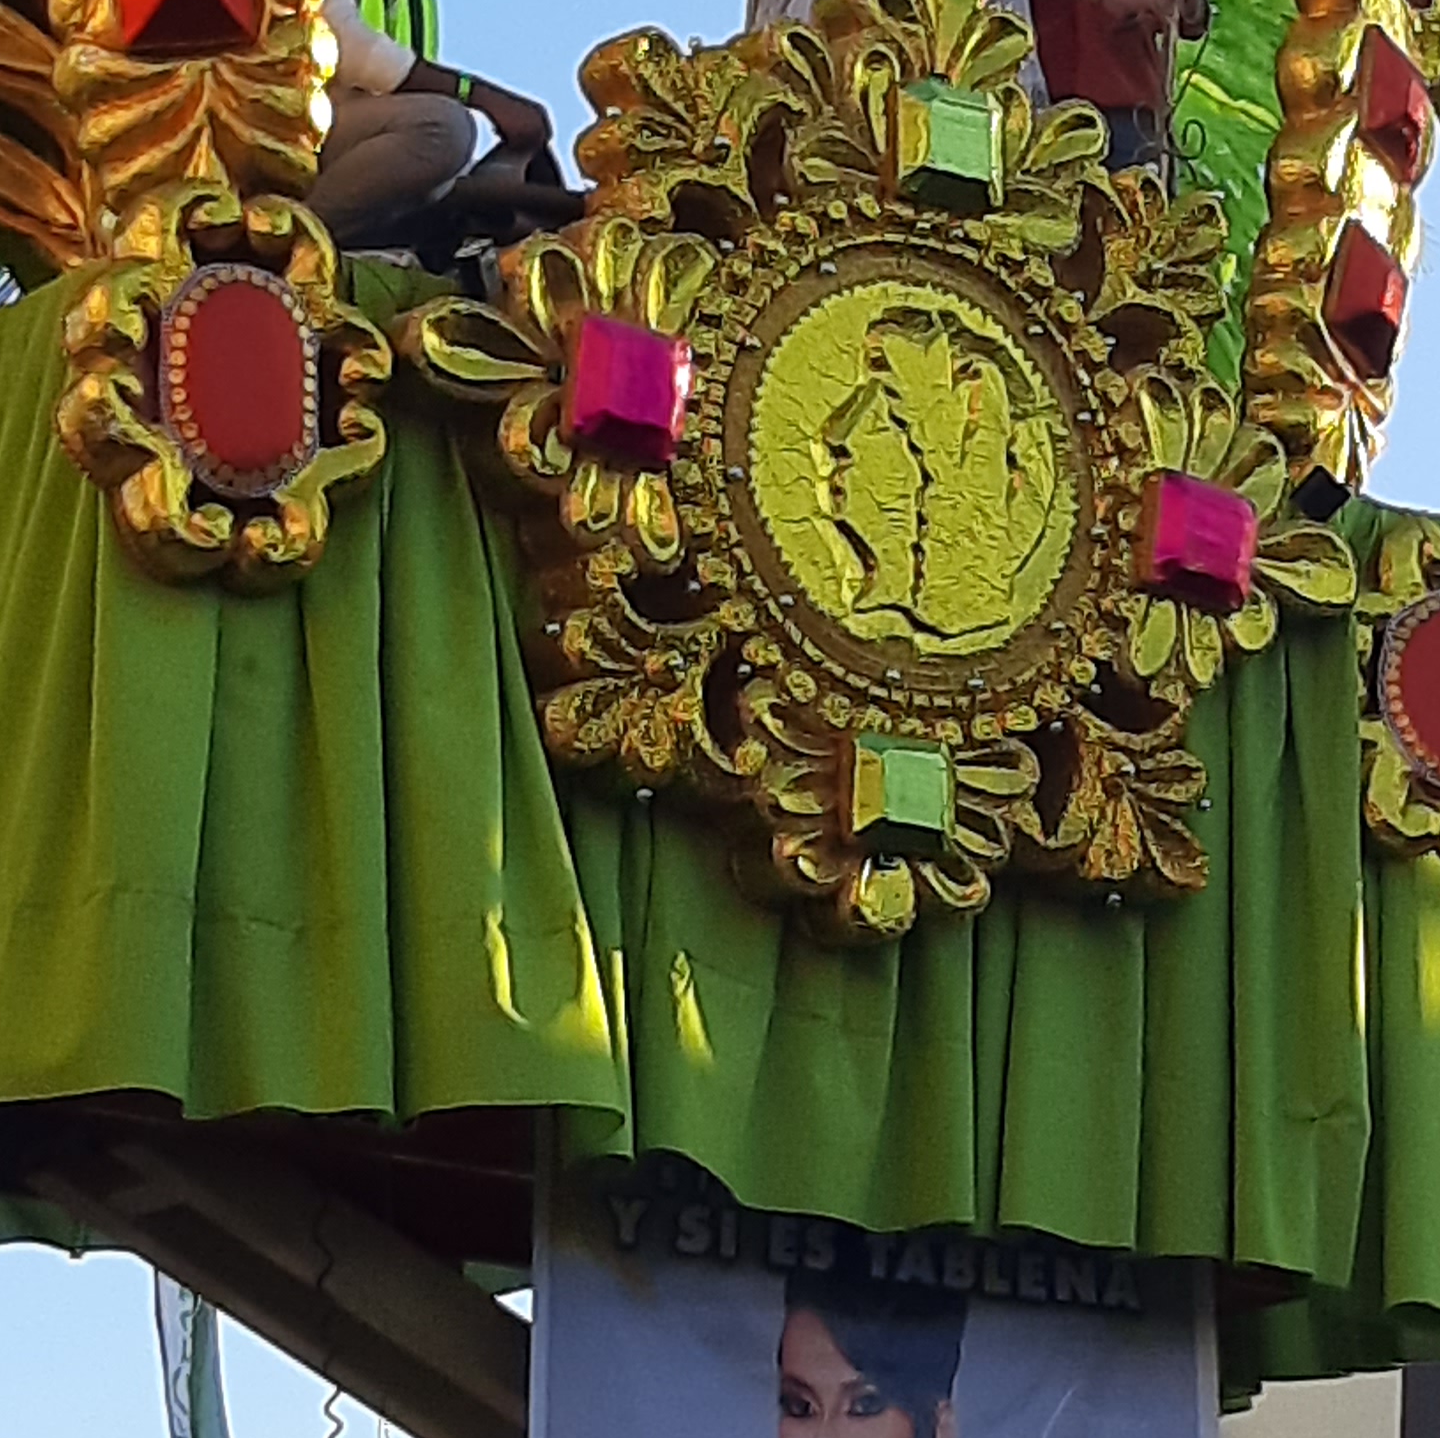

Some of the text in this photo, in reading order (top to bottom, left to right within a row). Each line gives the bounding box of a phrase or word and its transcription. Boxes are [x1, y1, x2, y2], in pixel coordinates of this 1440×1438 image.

[608, 1195, 650, 1245] Y
[675, 1203, 739, 1257] SI
[768, 1217, 837, 1269] ES
